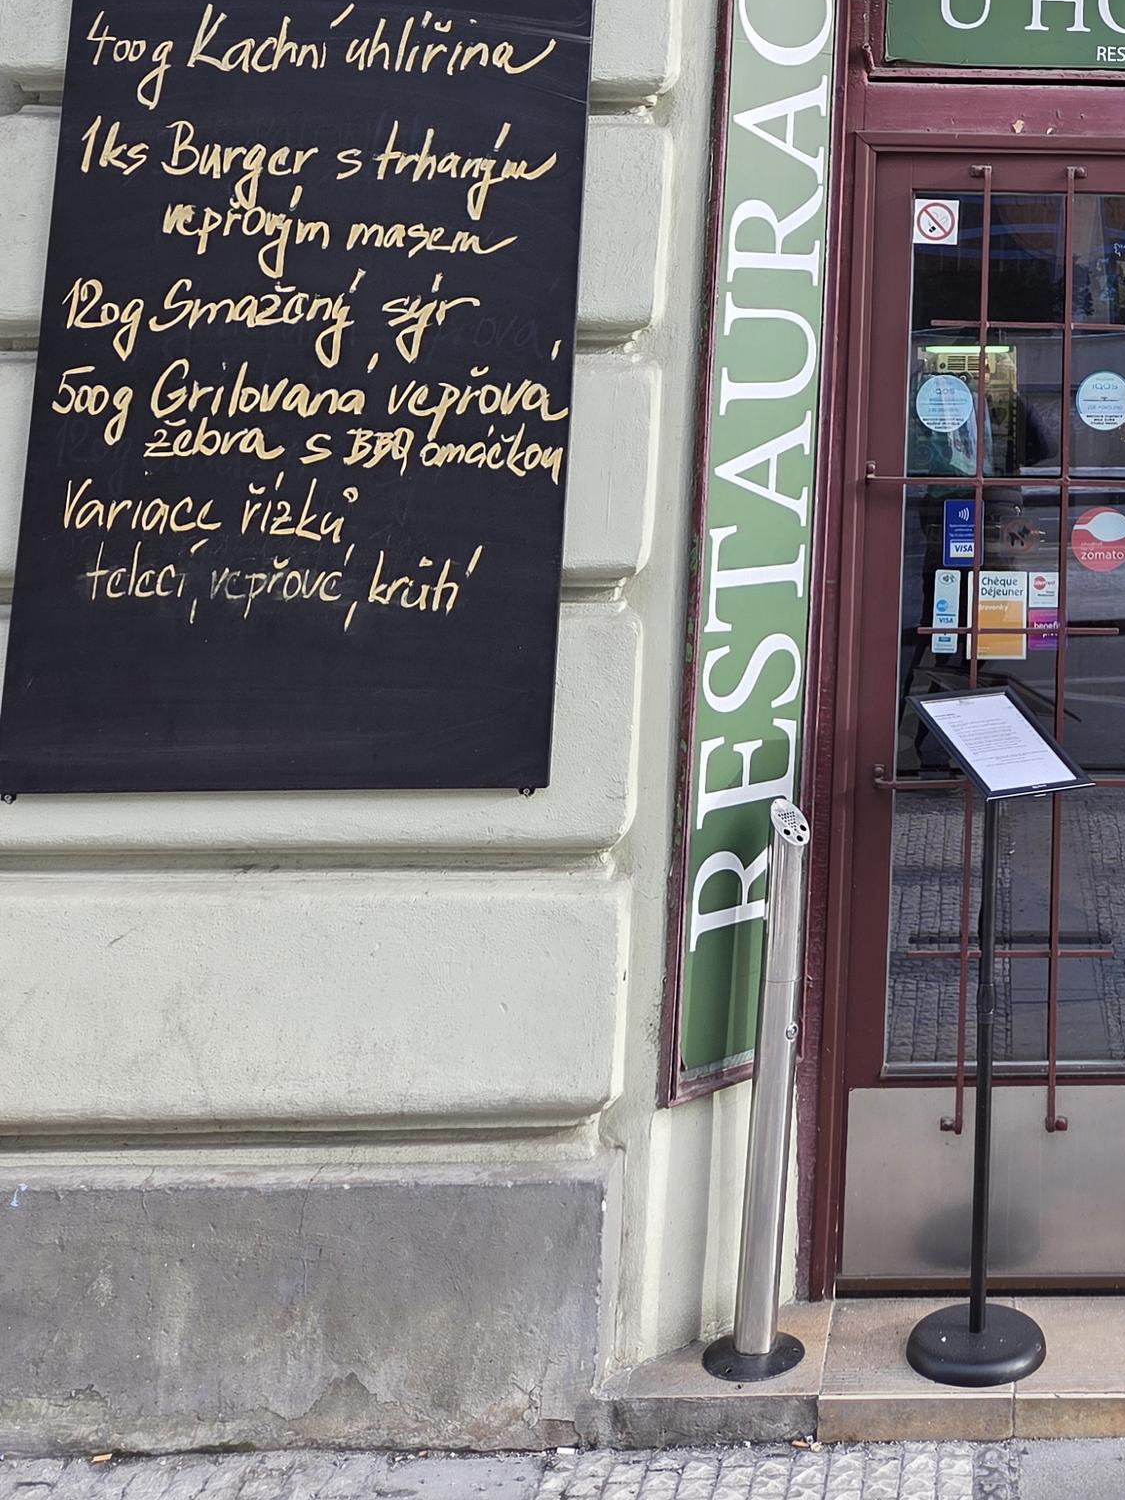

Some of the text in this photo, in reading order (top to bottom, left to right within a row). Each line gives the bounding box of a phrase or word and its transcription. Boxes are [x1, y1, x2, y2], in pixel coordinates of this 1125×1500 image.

[86, 10, 174, 110] 400g
[187, 3, 354, 74] Kachní
[81, 115, 150, 176] 1ks
[161, 120, 319, 210] Burger
[336, 148, 363, 181] s
[162, 185, 518, 279] vepřovým masem
[62, 277, 145, 362] 120g
[382, 272, 480, 364] sýr
[52, 365, 134, 446] 500g
[143, 416, 286, 460] žebra
[299, 433, 333, 465] s
[63, 471, 360, 543] Variace řízků
[981, 576, 1018, 587] Chèque
[981, 587, 1024, 598] Déjeuner
[1081, 550, 1124, 560] zomato
